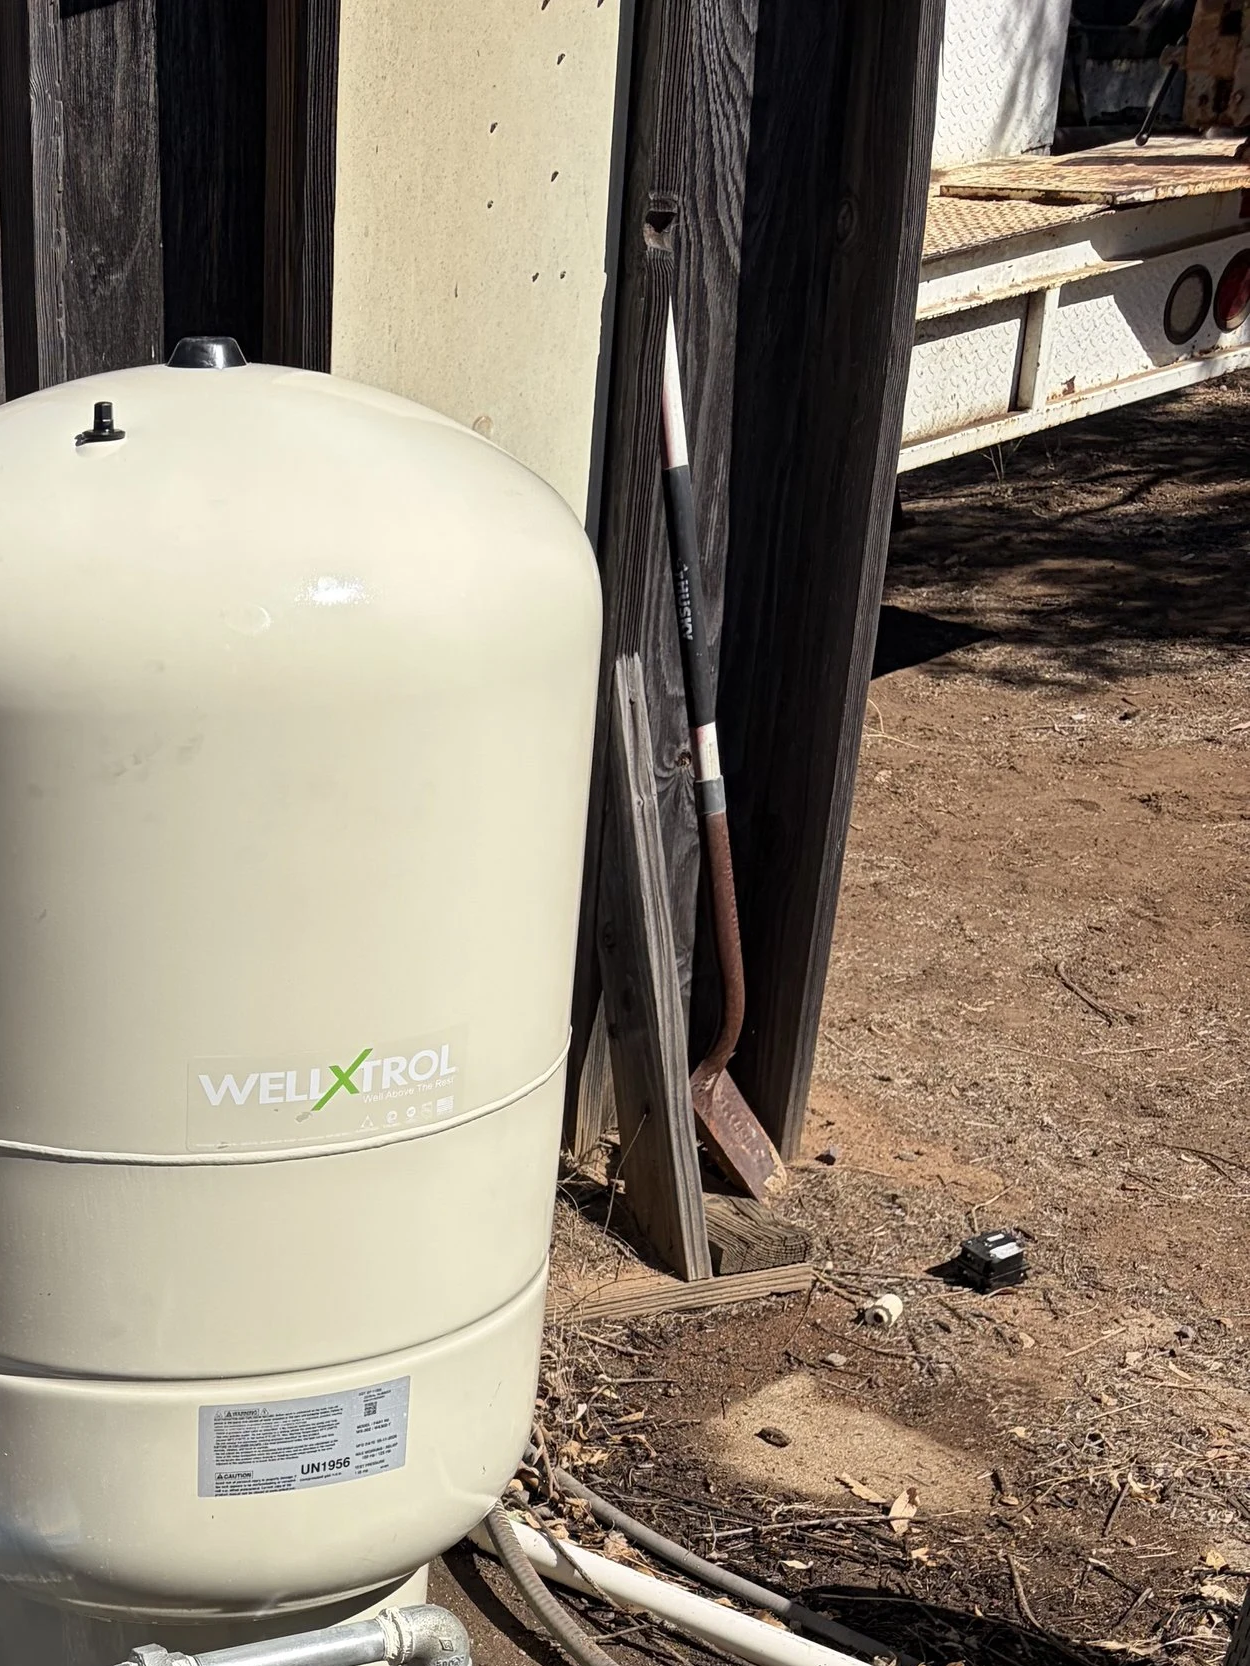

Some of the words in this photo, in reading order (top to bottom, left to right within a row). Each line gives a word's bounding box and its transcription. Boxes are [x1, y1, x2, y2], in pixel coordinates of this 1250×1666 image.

[677, 579, 694, 641] HUSKY
[198, 1044, 458, 1112] WELLXTROL
[362, 1093, 384, 1103] Well
[385, 1088, 414, 1100] Above
[417, 1083, 433, 1092] The
[301, 1456, 351, 1475] UN1956
[223, 1472, 252, 1480] CAUTION
